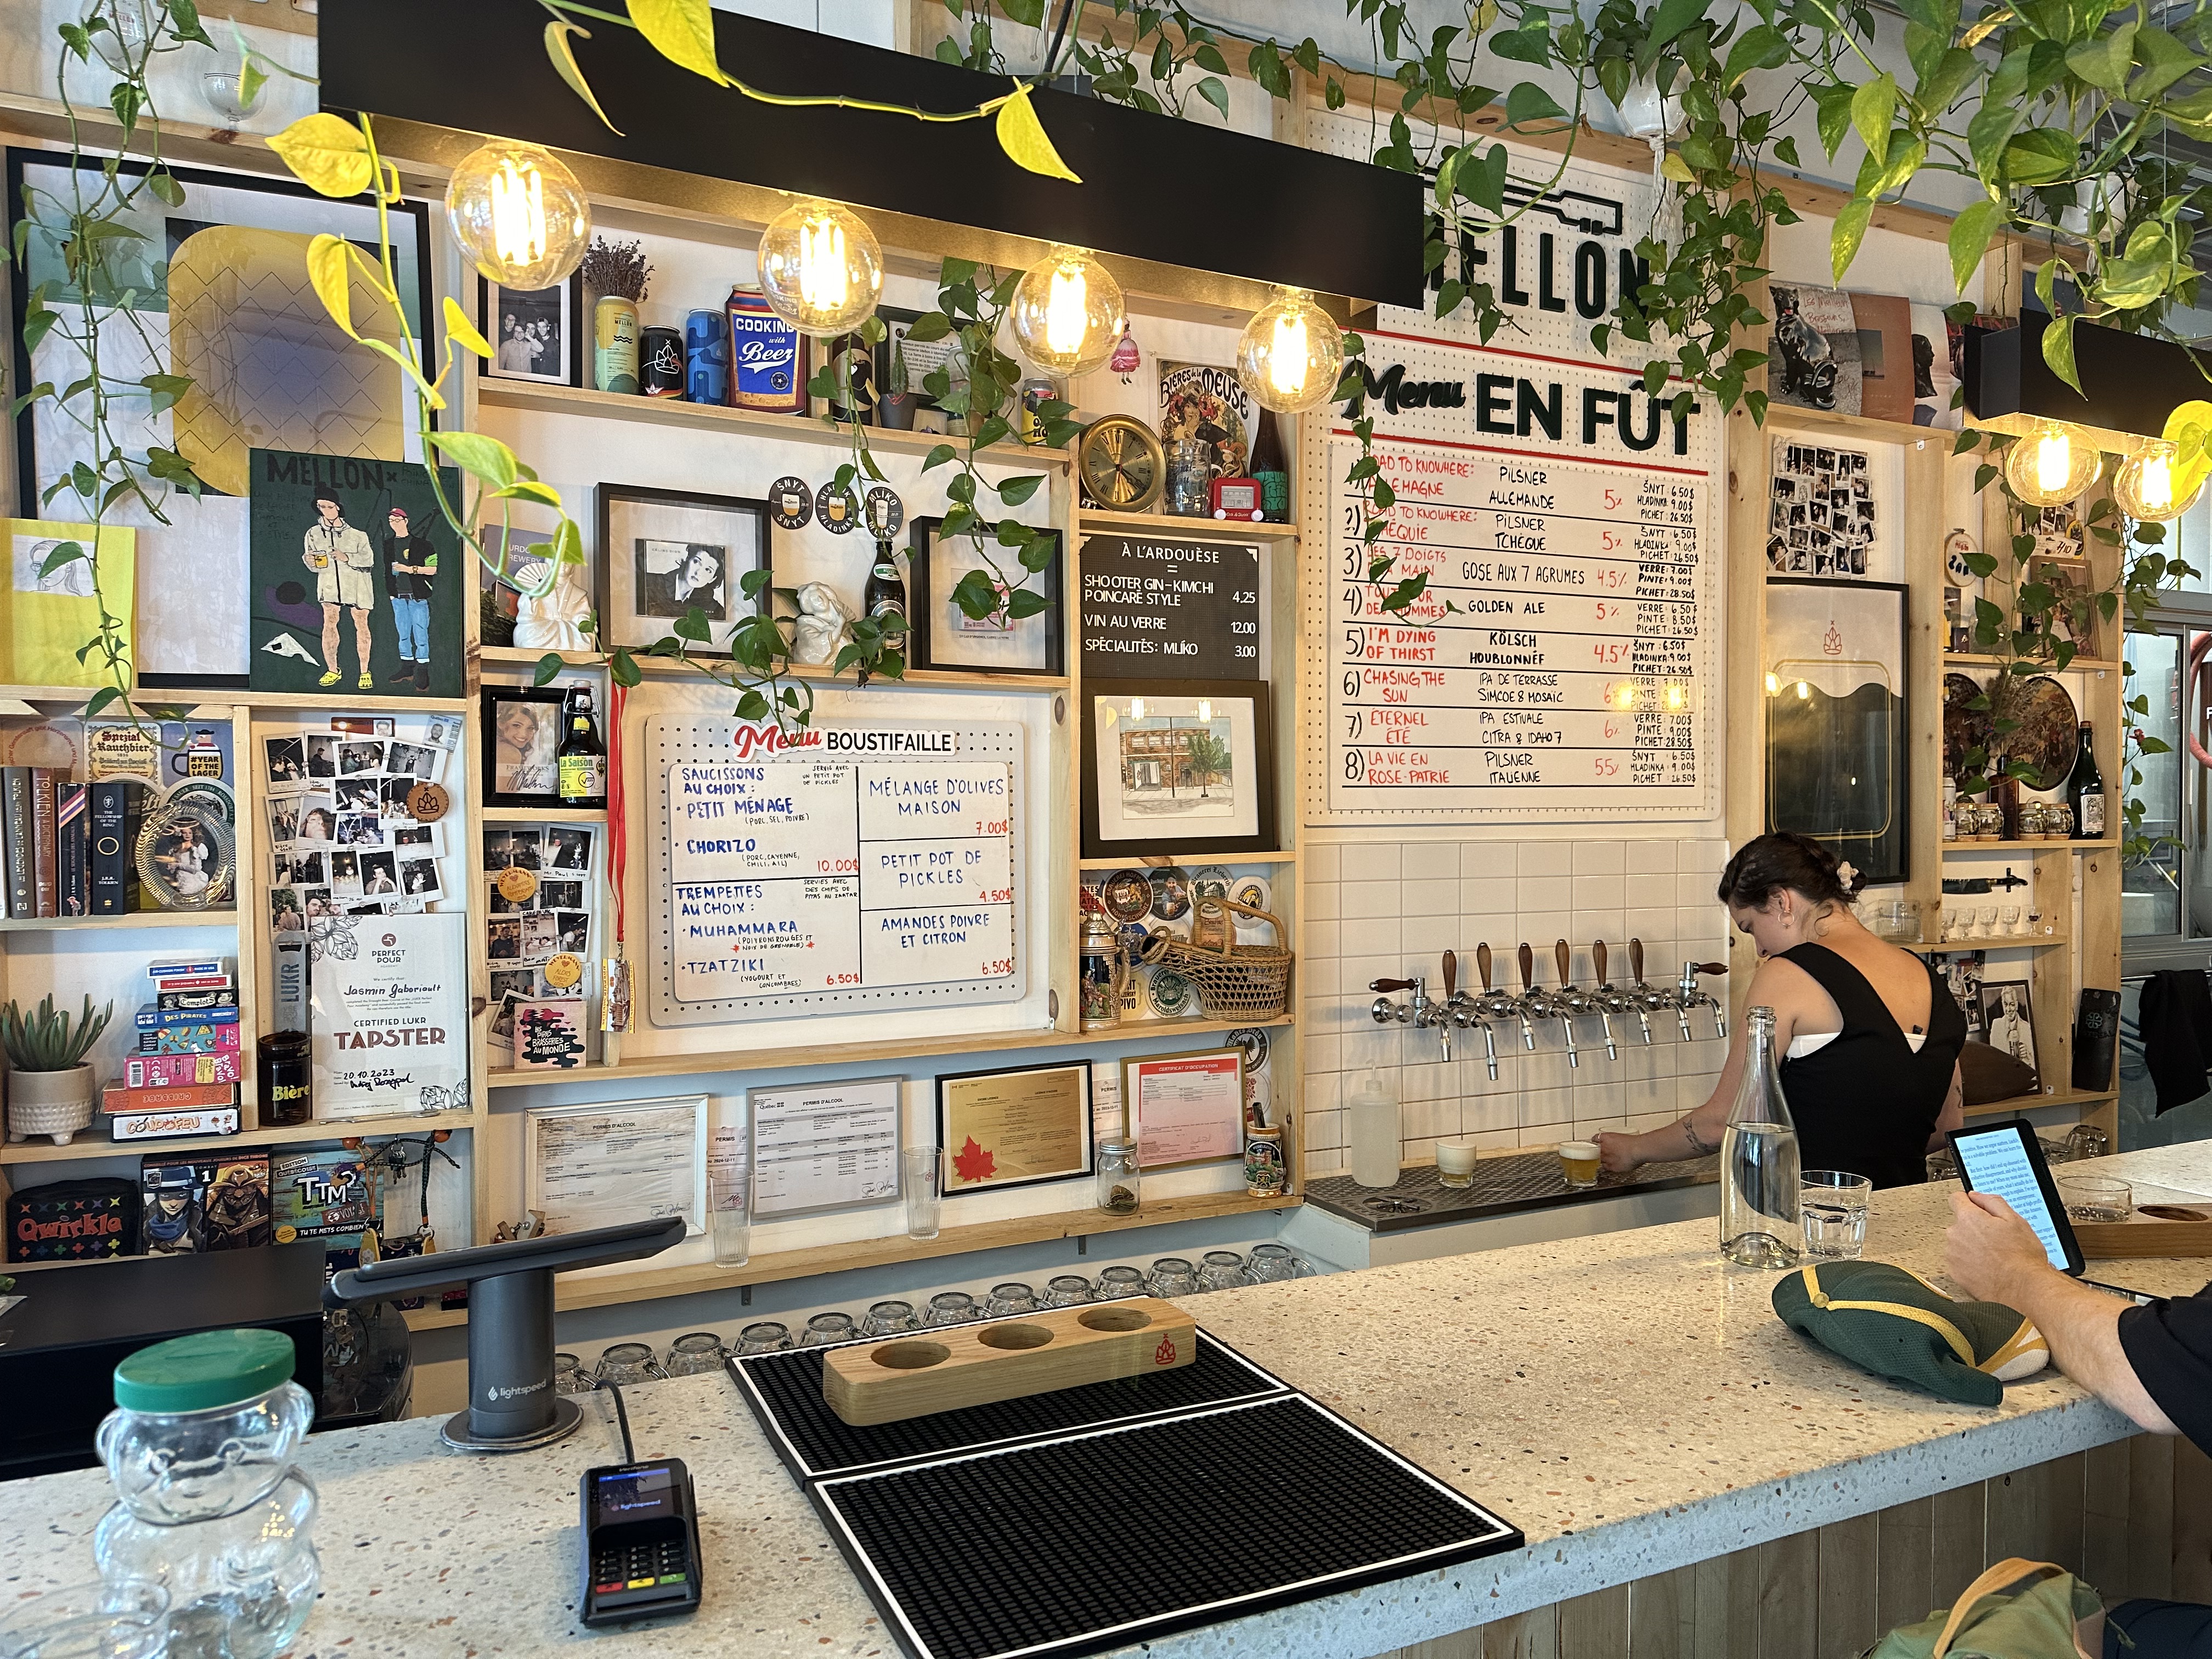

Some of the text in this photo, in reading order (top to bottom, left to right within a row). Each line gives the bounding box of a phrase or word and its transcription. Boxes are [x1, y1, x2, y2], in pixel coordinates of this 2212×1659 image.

[736, 318, 795, 332] COOKING
[738, 345, 793, 362] Beer
[1160, 368, 1249, 419] BIÈRES MEUSE
[1340, 359, 1701, 455] Menu EN FÛT
[1399, 456, 1547, 486] TO KNOWHERE: PILSNER
[776, 479, 804, 491] ŠNYT
[869, 489, 897, 506] MLÍKO
[1489, 490, 1554, 509] ALLEMANDE
[1400, 506, 1545, 531] TO KNOWHERE: PILSNER
[1122, 542, 1220, 563] À L'ARDOUÈSE
[1344, 544, 1446, 578] 3) DOIGTS
[1402, 562, 1627, 588] MAIN GOSE AUX 7 AGRUMES 4.5%
[1085, 575, 1214, 594] SHOOTER GIN-KIMCHI
[1085, 589, 1255, 606] POINCARÉ STYLE 4.25
[1343, 586, 1362, 616] 4)
[1469, 600, 1545, 613] GOLDEN ALE
[1085, 614, 1256, 634] VIN AU VERRE 12.00
[1164, 640, 1198, 655] MLÍKO
[1235, 646, 1256, 657] 3.00
[1346, 627, 1536, 657] 5) I'M DYING KÖLSCH
[1367, 644, 1629, 663] OF THIRST 4.5%
[1344, 668, 1558, 697] 6) CHASING THE IPA DE TERRASSE
[1383, 688, 1515, 703] SUN SIMCOE
[1345, 708, 1544, 739] 7) ÉTERNEL IPA ESTIVALE
[101, 731, 140, 742] Spezial
[827, 732, 951, 752] BOUSTIFAILLE
[1386, 727, 1553, 744] ÉTÉ CITRA IDAHO
[97, 742, 149, 753] Rauchbier
[561, 758, 592, 767] La Saison
[1345, 749, 1533, 781] 8) LA VIE EN PILSNER
[682, 768, 764, 781] SAUCISSONS
[685, 783, 701, 795] AU
[707, 783, 746, 795] CHOIX
[870, 777, 1003, 797] MÉLANGE D'OLIVES
[687, 797, 793, 819] PETIT MÉNAGE
[899, 799, 960, 816] MAISON
[976, 819, 1008, 835] 7.00$
[687, 839, 755, 854] CHORIZO
[817, 858, 859, 872] 10.00$
[882, 850, 981, 869] PETIT POT DE
[900, 869, 963, 889] PICKLES
[675, 885, 763, 900] TREMPETTES
[979, 888, 1011, 902] 4.50$
[682, 904, 700, 916] AU
[704, 902, 744, 915] CHOIX
[691, 921, 798, 938] MUHAMMARA
[882, 914, 989, 932] AMANDES POIVRE
[901, 932, 966, 948] ET CITRON
[687, 958, 764, 974] TZATZIKI
[982, 958, 1012, 974] 6.50$
[826, 973, 859, 985] 6.50$
[344, 985, 385, 996] Jasmin
[354, 1018, 399, 1027] CERTIFIED
[334, 1028, 445, 1050] TAPSTER
[543, 1042, 570, 1055] MONDE
[272, 1084, 309, 1101] Bière
[176, 1117, 200, 1128] FEU
[202, 1171, 211, 1182] 1
[18, 1214, 122, 1242] Qwirkle
[500, 1380, 546, 1397] lightspeed
